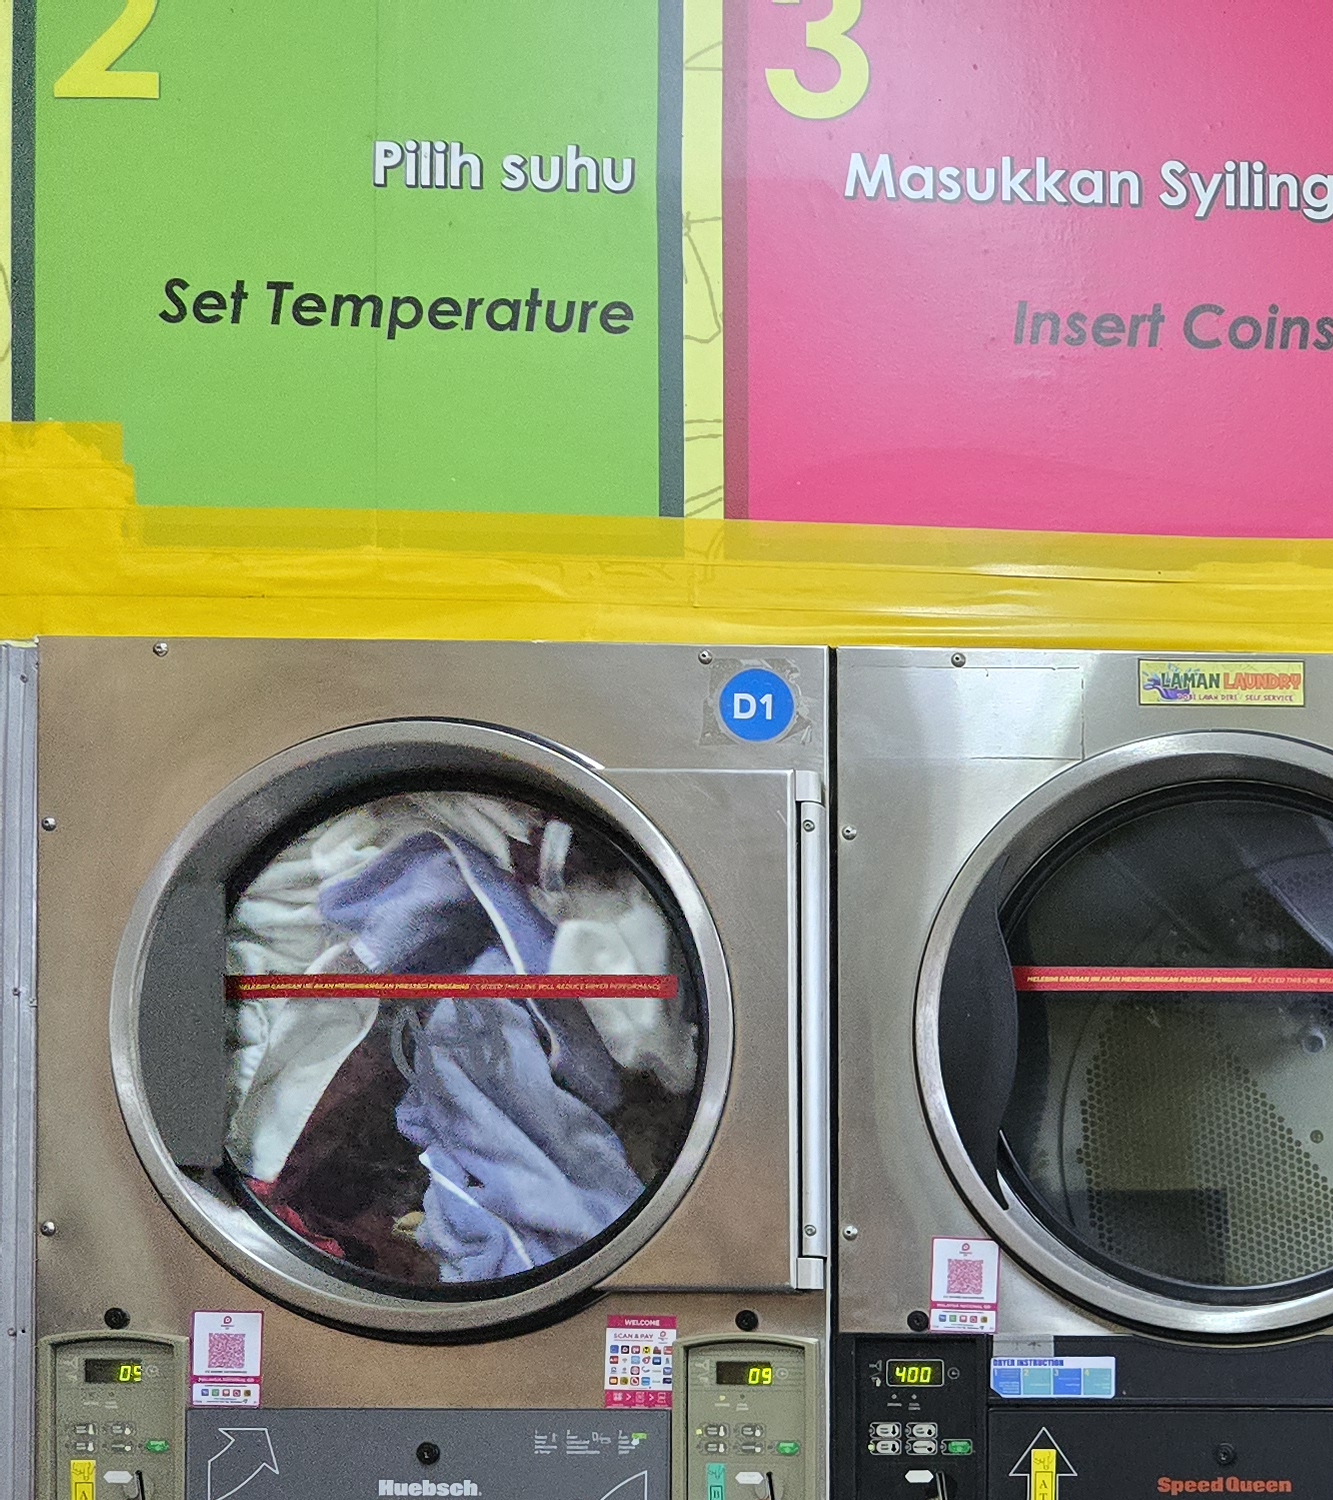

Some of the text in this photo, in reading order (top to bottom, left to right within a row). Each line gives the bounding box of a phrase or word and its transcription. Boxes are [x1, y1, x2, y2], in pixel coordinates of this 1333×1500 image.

[52, 0, 161, 99] 2
[765, 0, 871, 121] 3
[374, 139, 635, 196] Pilih suhu
[845, 151, 1141, 208] Masukkan
[160, 277, 636, 341] Set Temperature
[1013, 302, 1162, 351] Insert
[1161, 672, 1302, 691] LAMAN LAUNDRY
[733, 693, 773, 720] D1
[625, 1318, 660, 1327] WELCOME
[748, 1367, 772, 1385] 09
[895, 1366, 931, 1383] 400
[1157, 1476, 1292, 1496] Speed Queen
